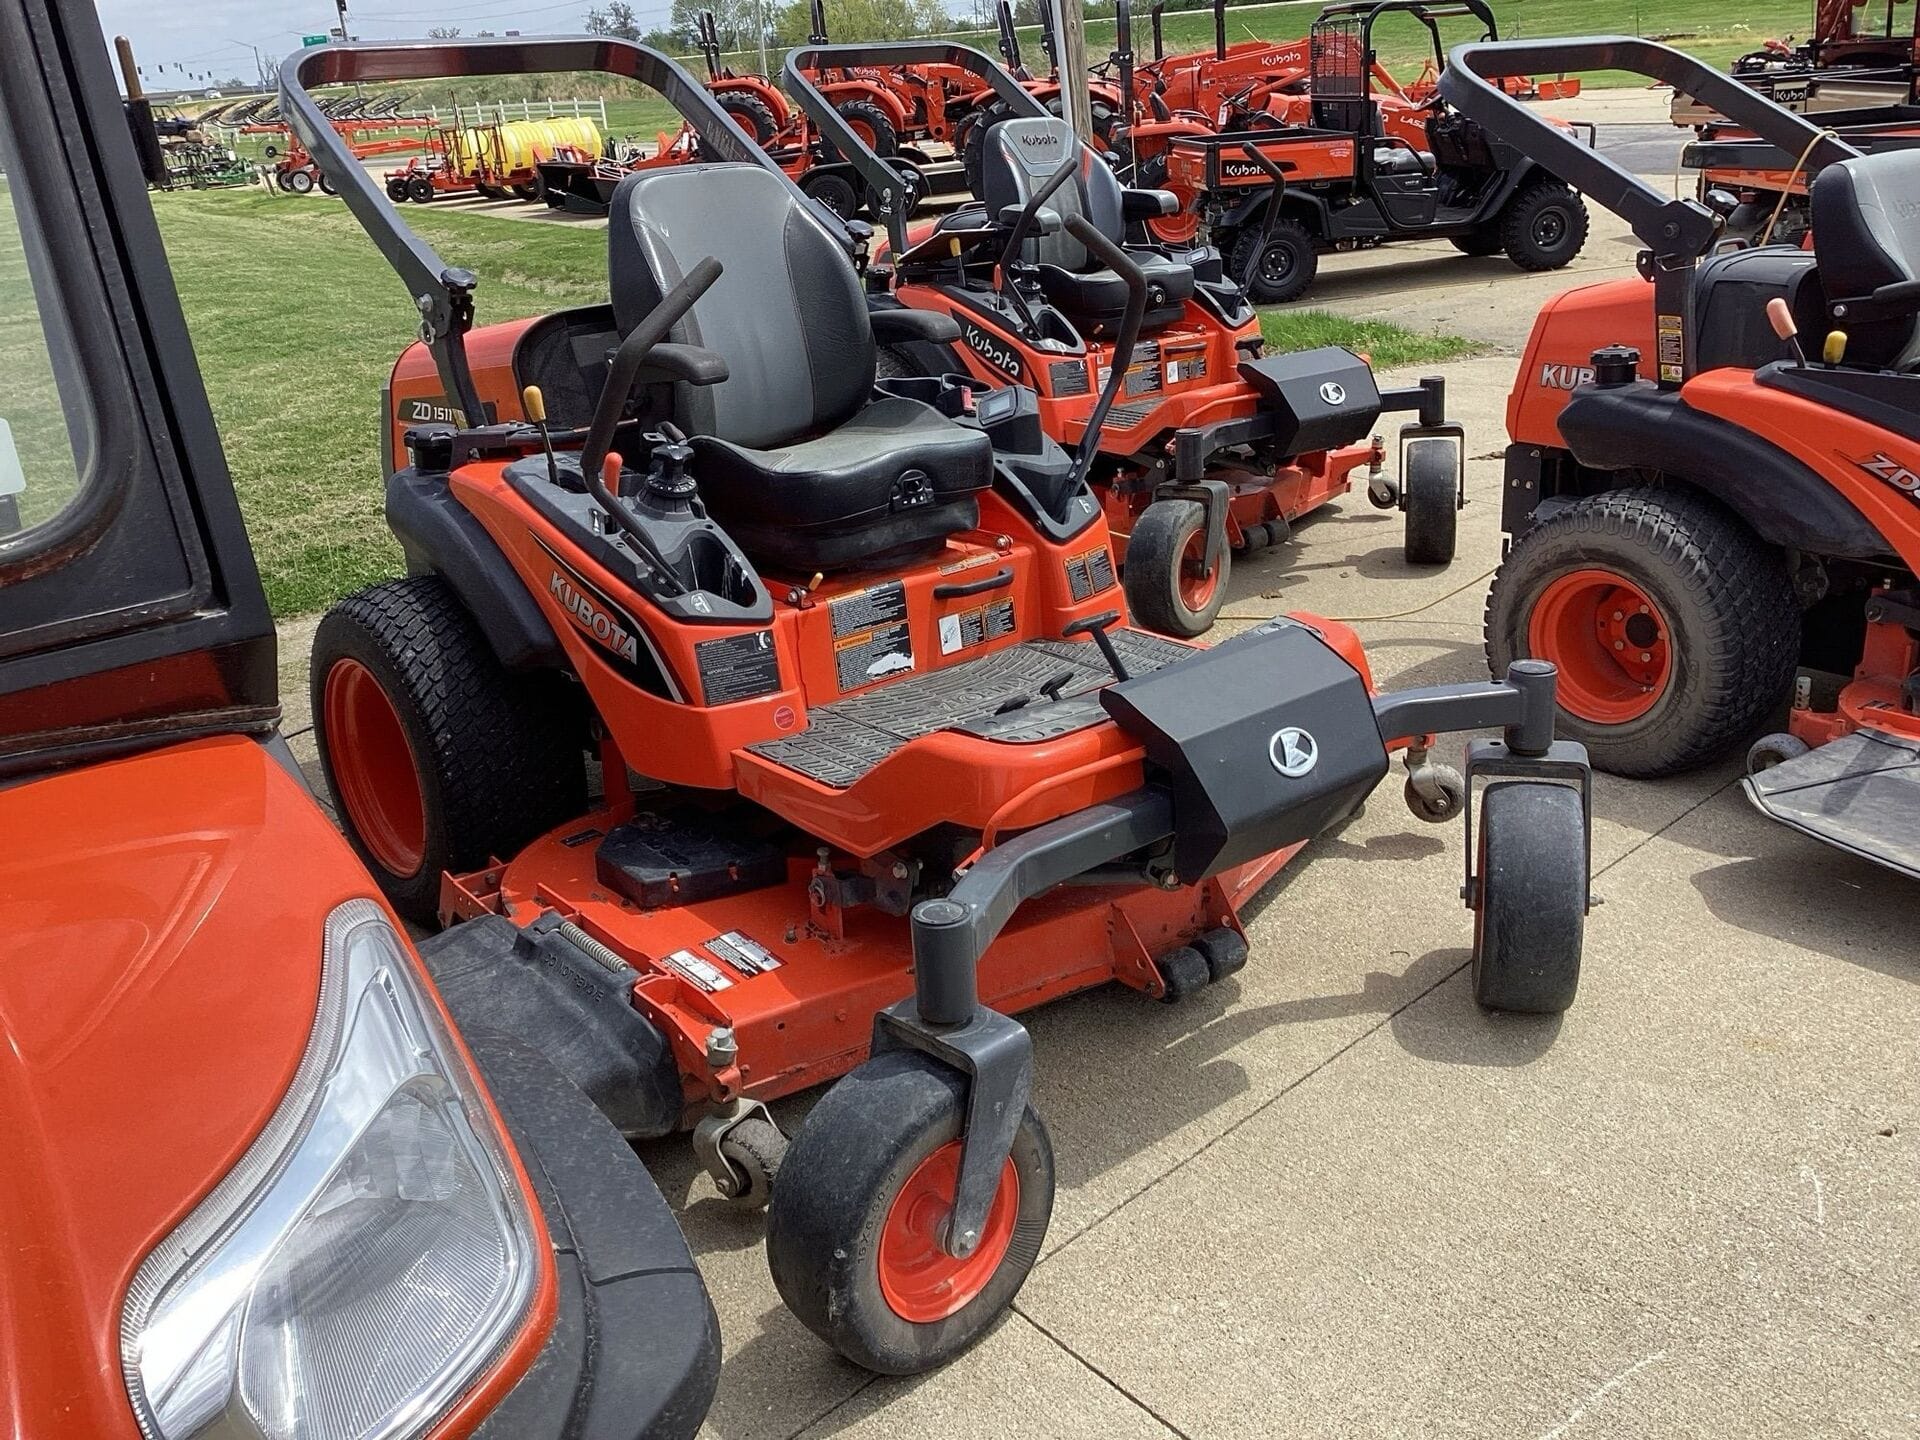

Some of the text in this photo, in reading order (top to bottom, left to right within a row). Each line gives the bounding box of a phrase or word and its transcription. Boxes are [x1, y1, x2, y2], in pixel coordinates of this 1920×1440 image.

[1261, 51, 1301, 66] Kubota
[853, 66, 881, 76] Kubota
[1776, 89, 1807, 100] Kubot
[1400, 116, 1426, 130] LA52
[1021, 134, 1057, 146] Kubota
[1226, 164, 1267, 176] Kubot
[966, 324, 1020, 377] Kubota
[1541, 364, 1596, 391] KUB
[412, 401, 453, 422] ZD 1511
[1860, 453, 1920, 500] ZD
[550, 570, 637, 666] KUBOTA
